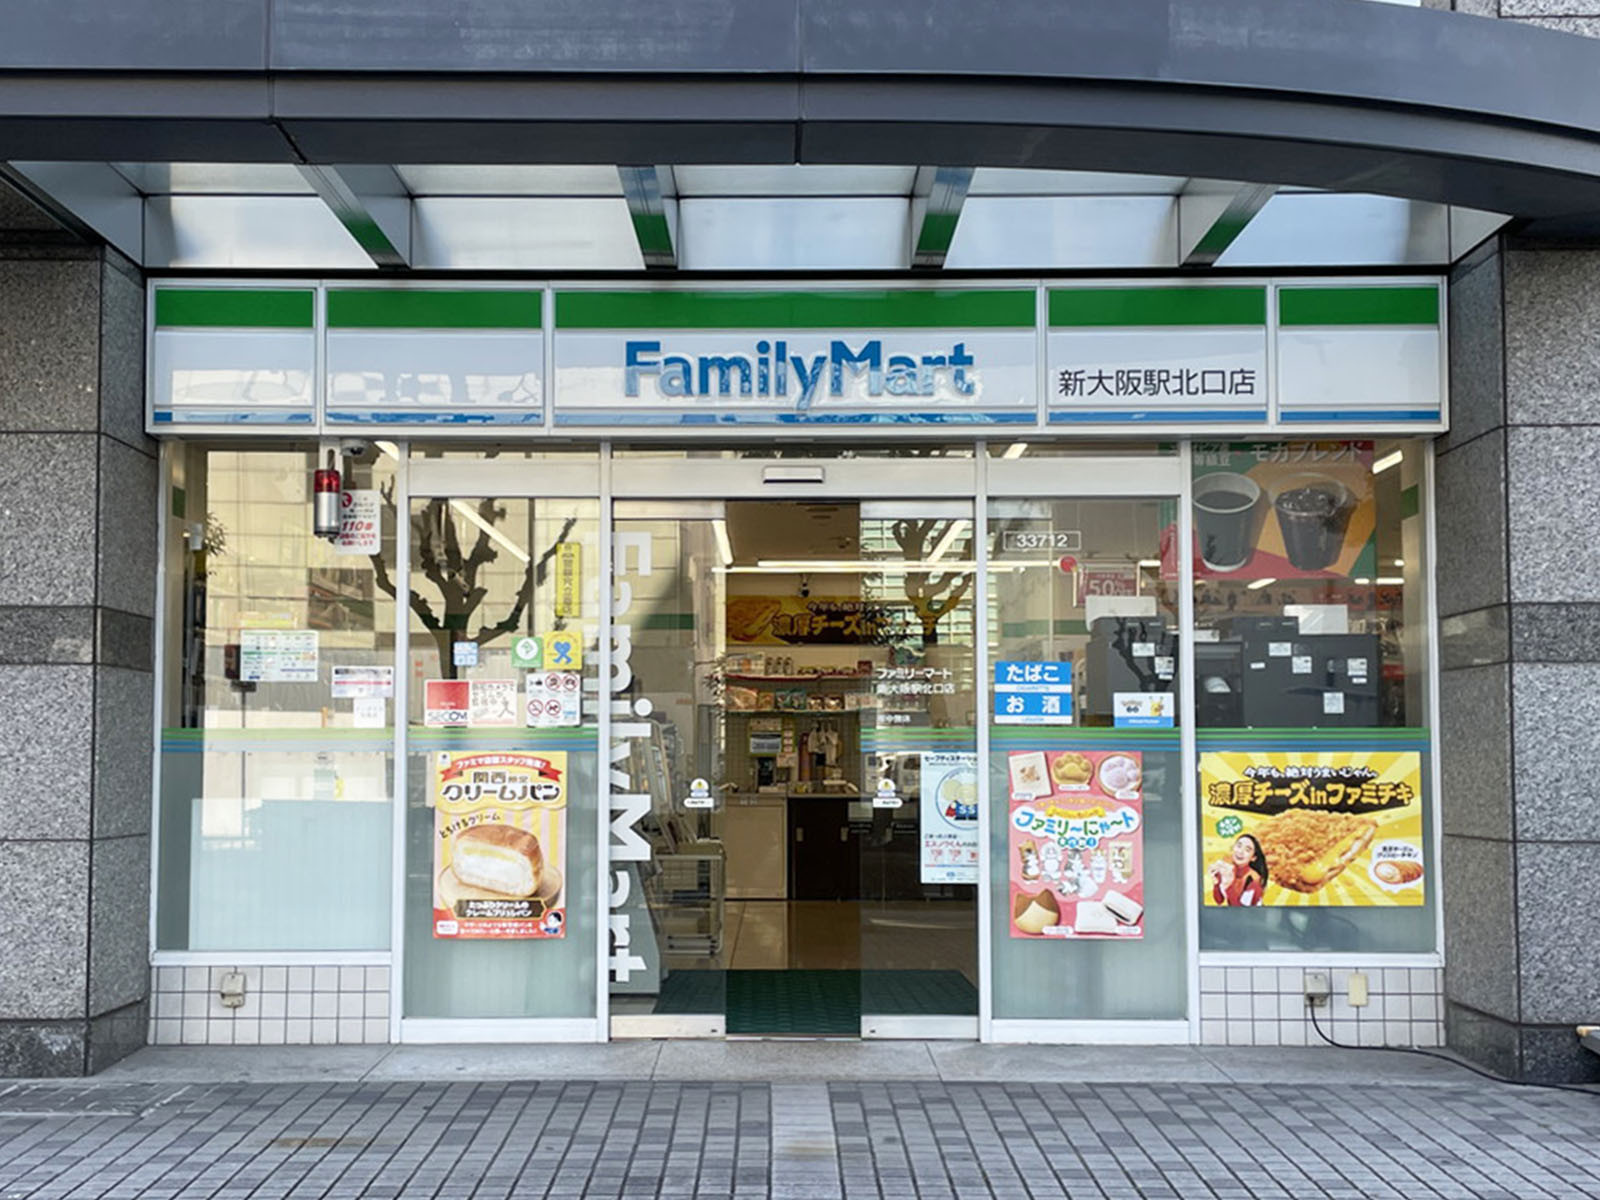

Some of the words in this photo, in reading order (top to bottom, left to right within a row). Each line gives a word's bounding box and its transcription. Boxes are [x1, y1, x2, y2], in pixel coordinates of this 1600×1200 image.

[625, 340, 975, 411] FamilyMart
[1058, 369, 1256, 397] 新大阪駅北口店
[1016, 534, 1068, 548] 33712
[876, 668, 953, 680] ファミリーマート
[1006, 663, 1060, 683] たばこ
[428, 711, 468, 722] SECOM
[442, 784, 560, 801] クリームパン
[1208, 780, 1414, 806] 濃厚チーズinファミチキ
